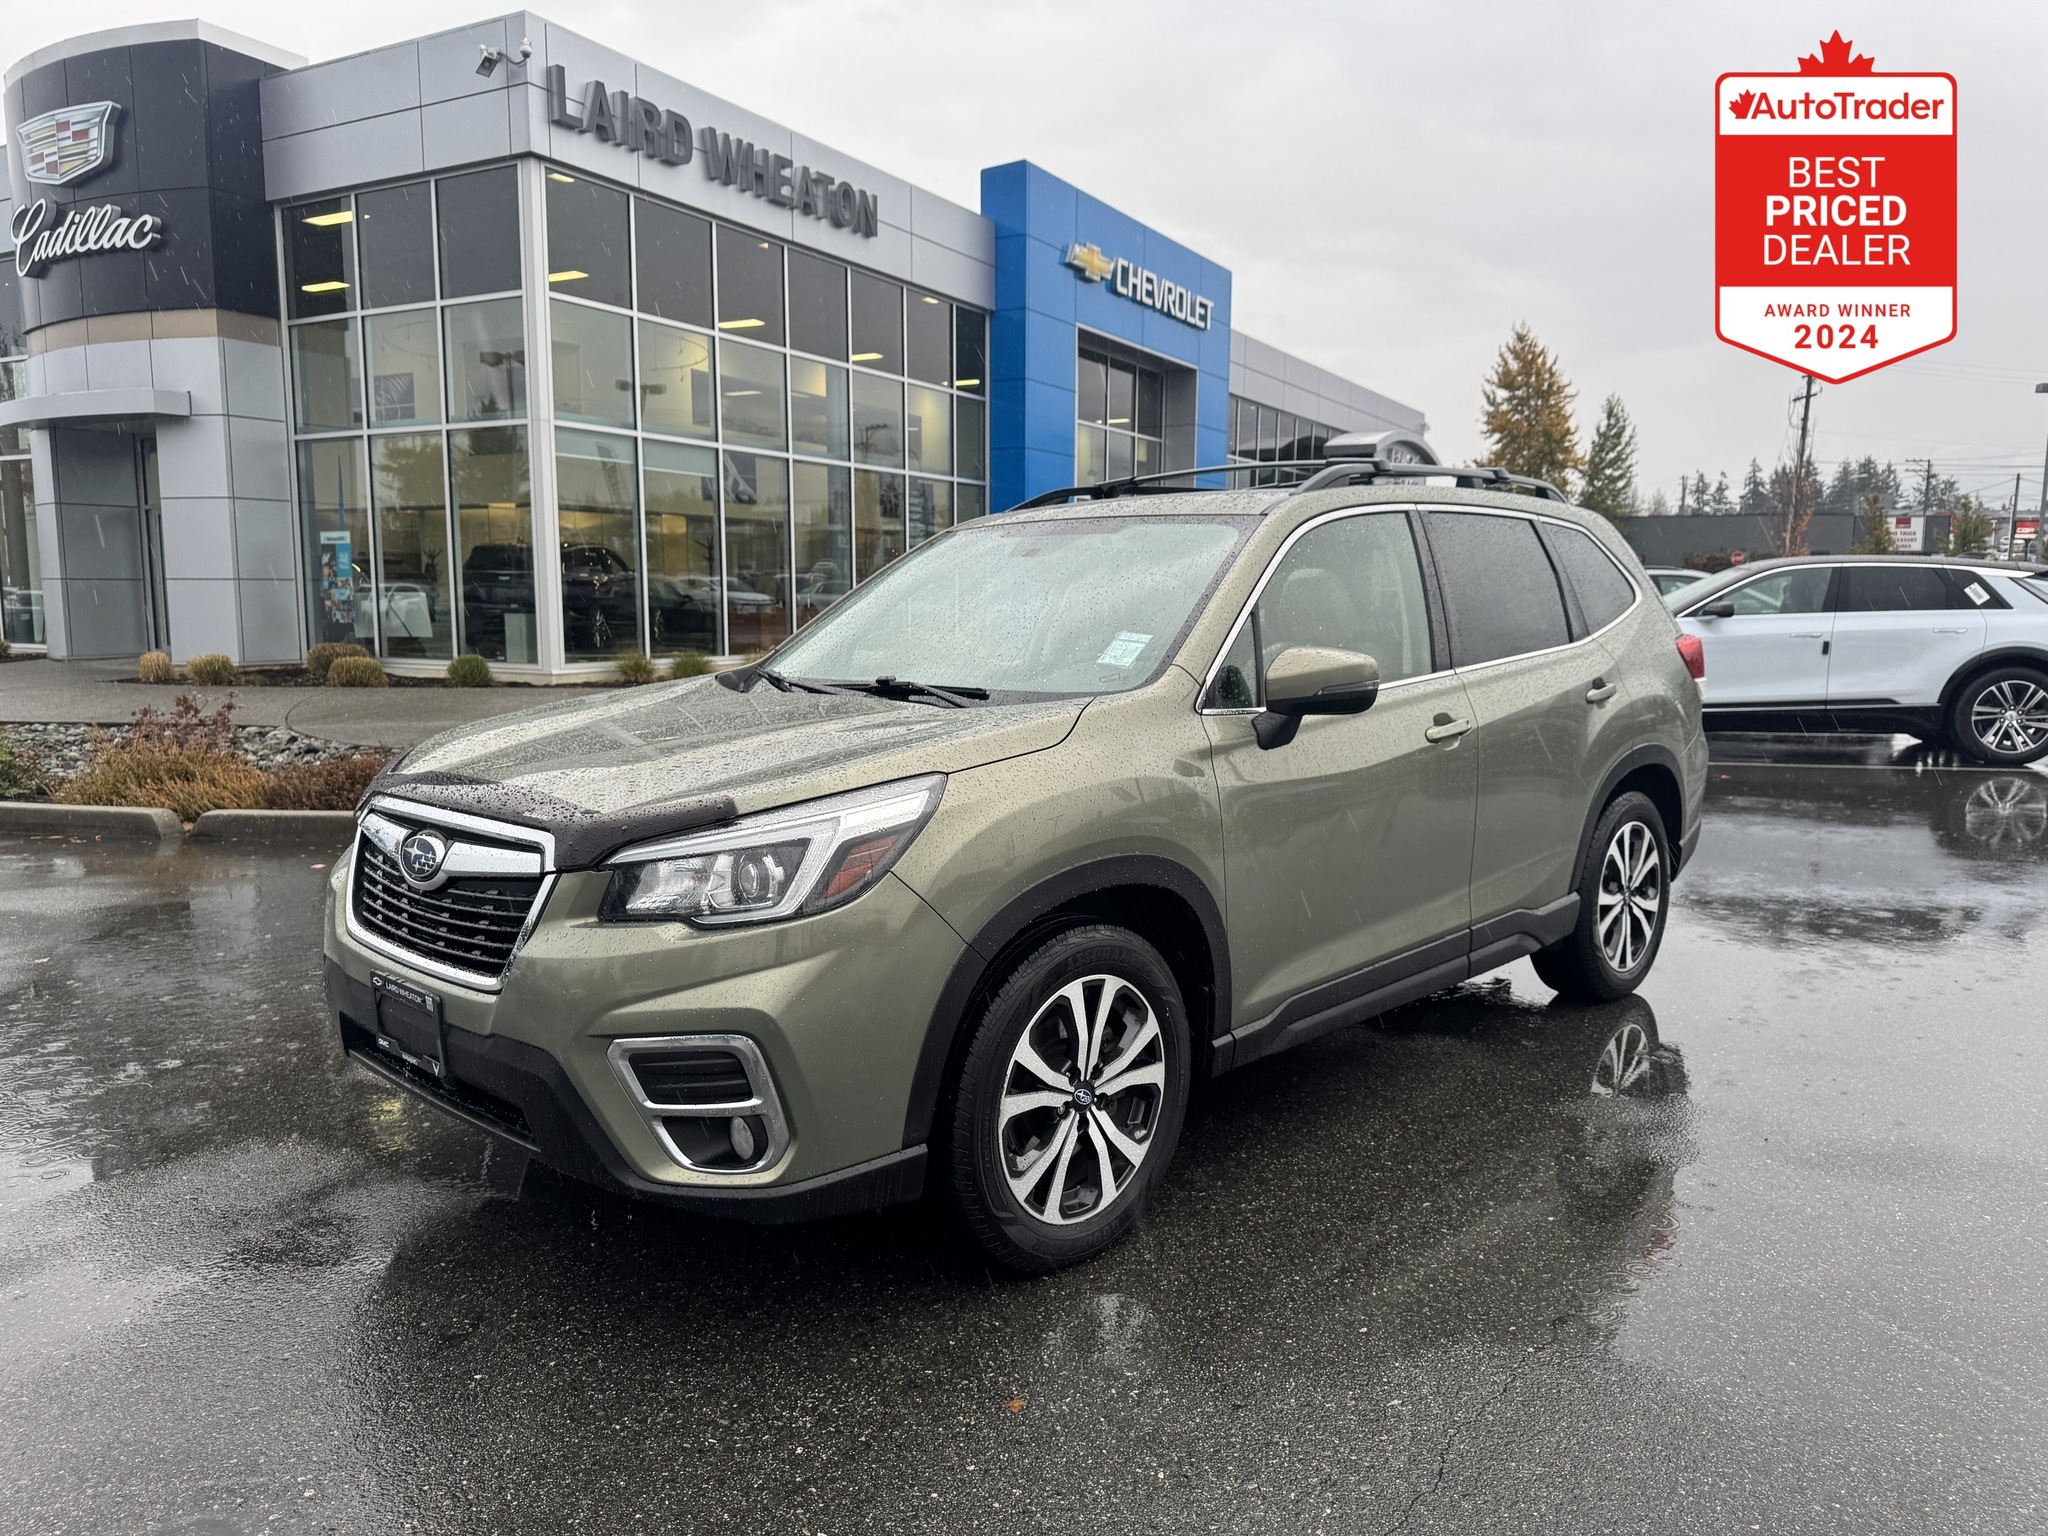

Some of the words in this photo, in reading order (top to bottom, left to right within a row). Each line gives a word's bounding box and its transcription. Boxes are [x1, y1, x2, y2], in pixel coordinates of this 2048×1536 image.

[548, 64, 693, 165] LAIRD
[702, 126, 877, 238] WHEATON
[10, 198, 157, 277] Cadillac
[1115, 256, 1214, 331] CHEVROLET
